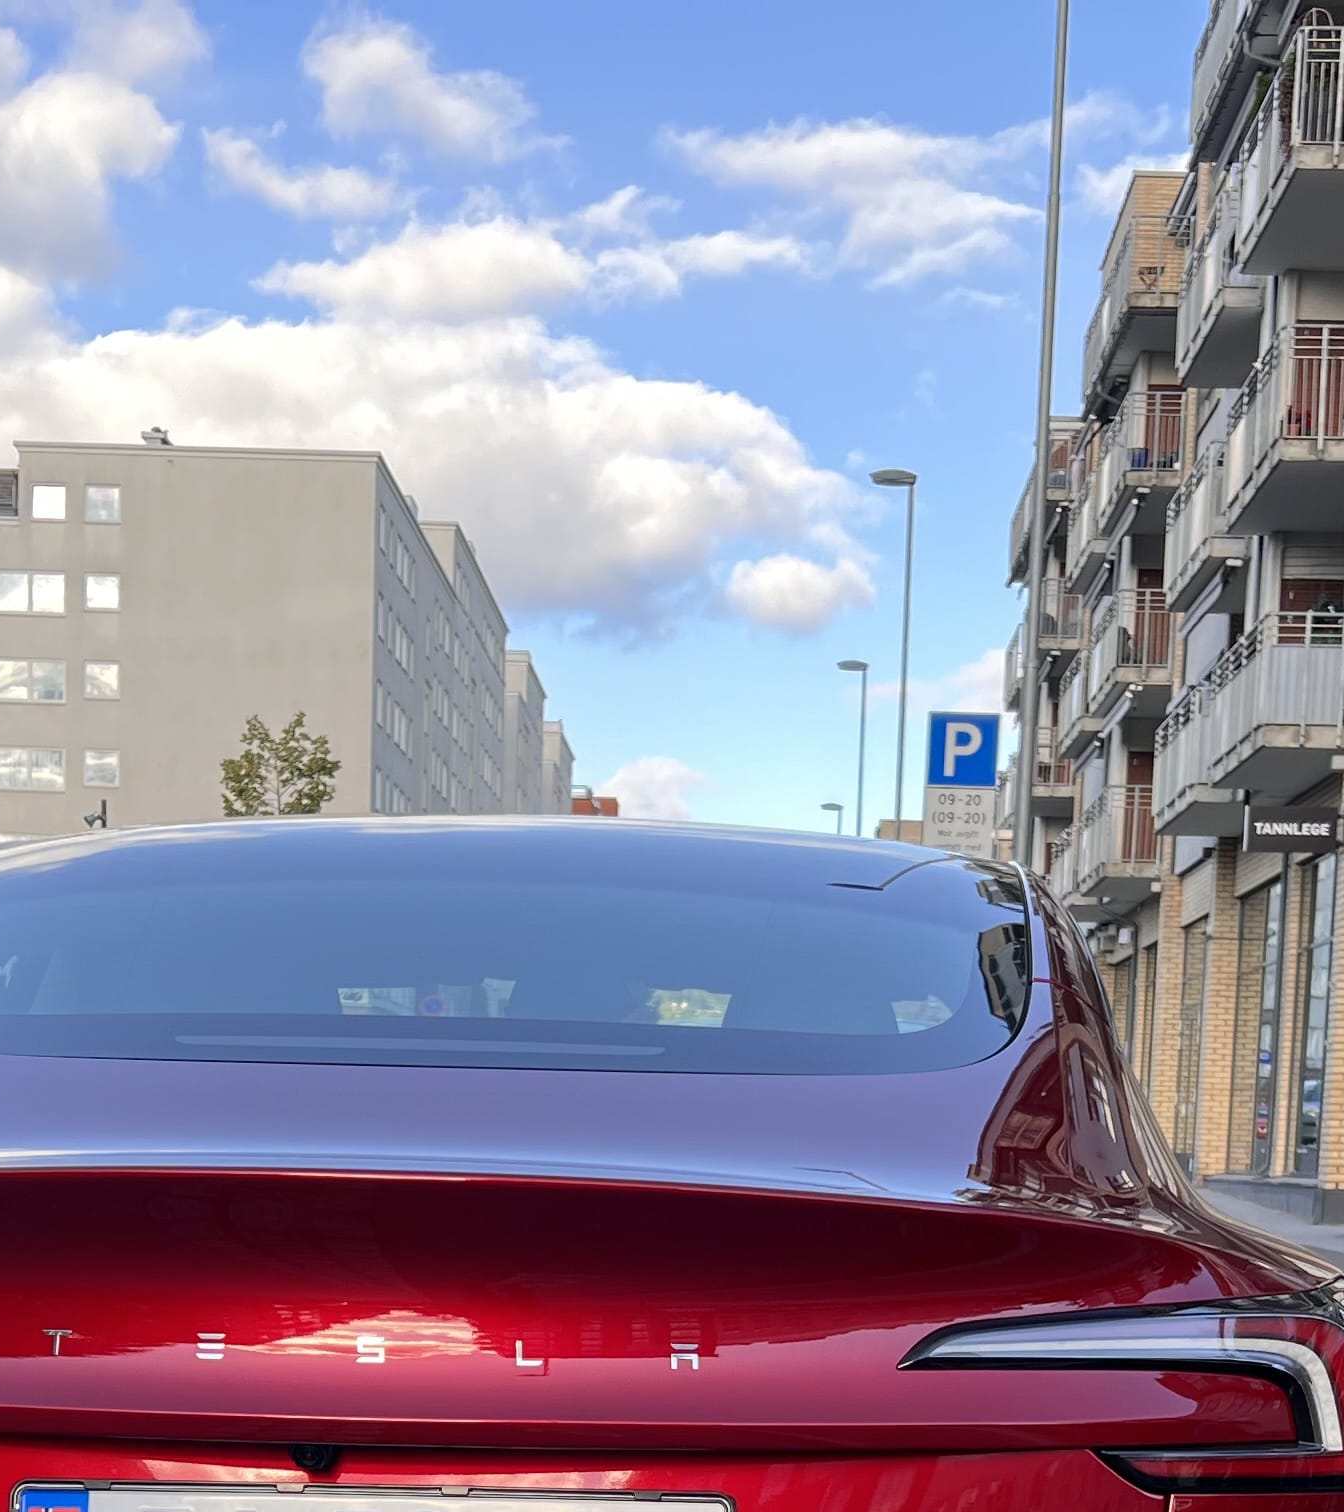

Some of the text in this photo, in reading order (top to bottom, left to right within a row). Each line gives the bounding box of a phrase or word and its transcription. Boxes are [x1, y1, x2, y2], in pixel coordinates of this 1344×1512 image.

[943, 722, 983, 777] P
[1253, 821, 1331, 837] TANNLEGE
[41, 1328, 700, 1370] TESLA
